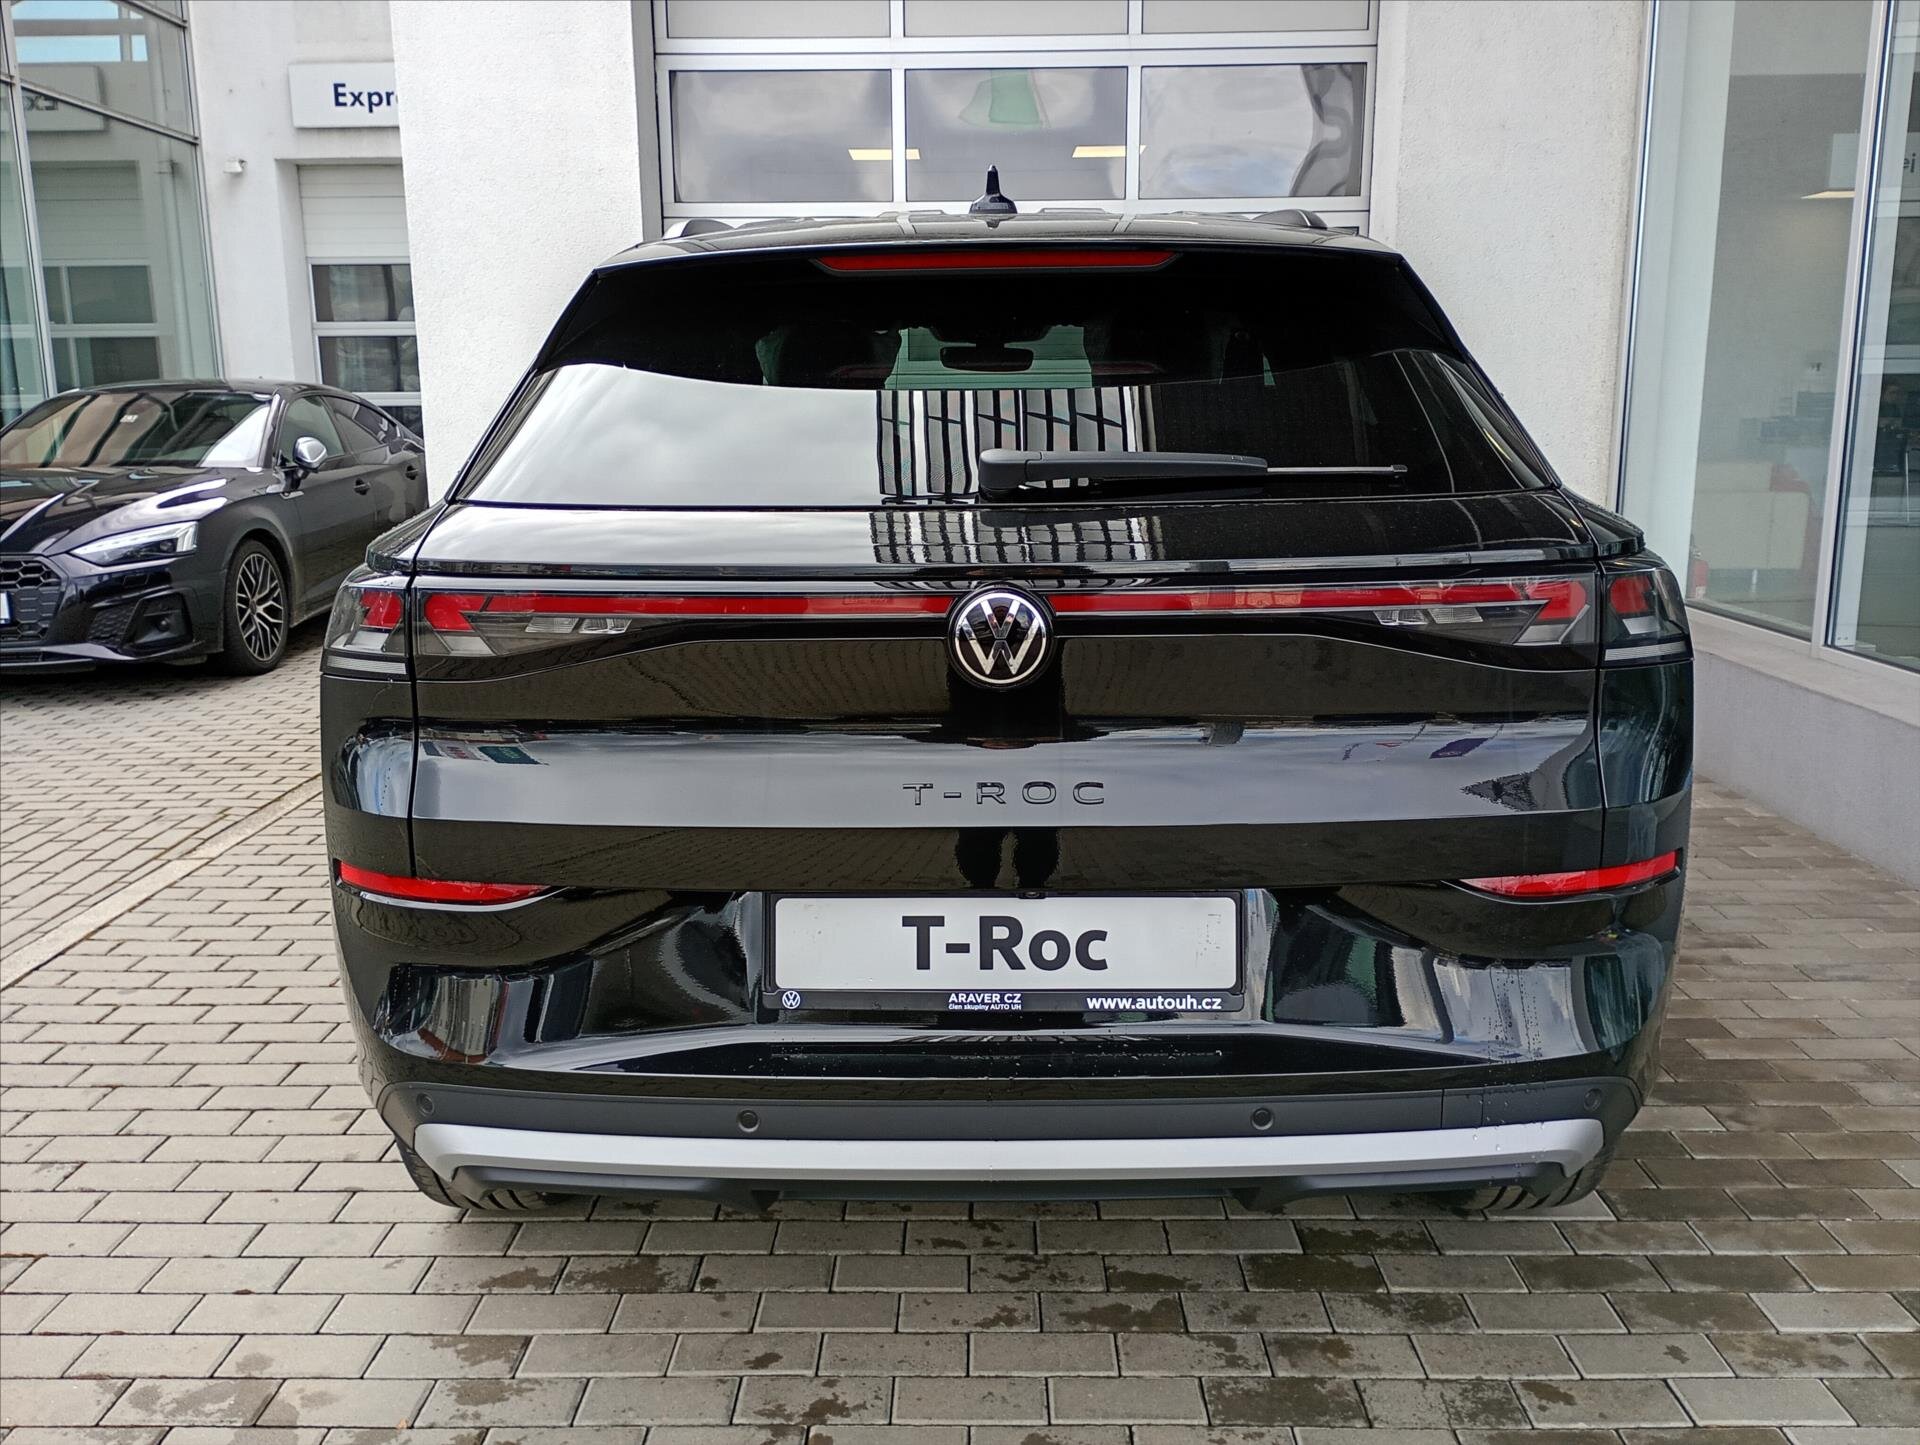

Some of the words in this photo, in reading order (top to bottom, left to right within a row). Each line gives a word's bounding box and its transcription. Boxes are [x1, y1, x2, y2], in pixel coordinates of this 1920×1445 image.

[333, 83, 398, 113] Expr
[903, 781, 1105, 806] T-ROC
[902, 916, 1108, 971] T-Roc
[948, 993, 1000, 1003] ARAVER
[1004, 993, 1021, 1003] CZ
[1086, 995, 1222, 1009] www.autouh.cz
